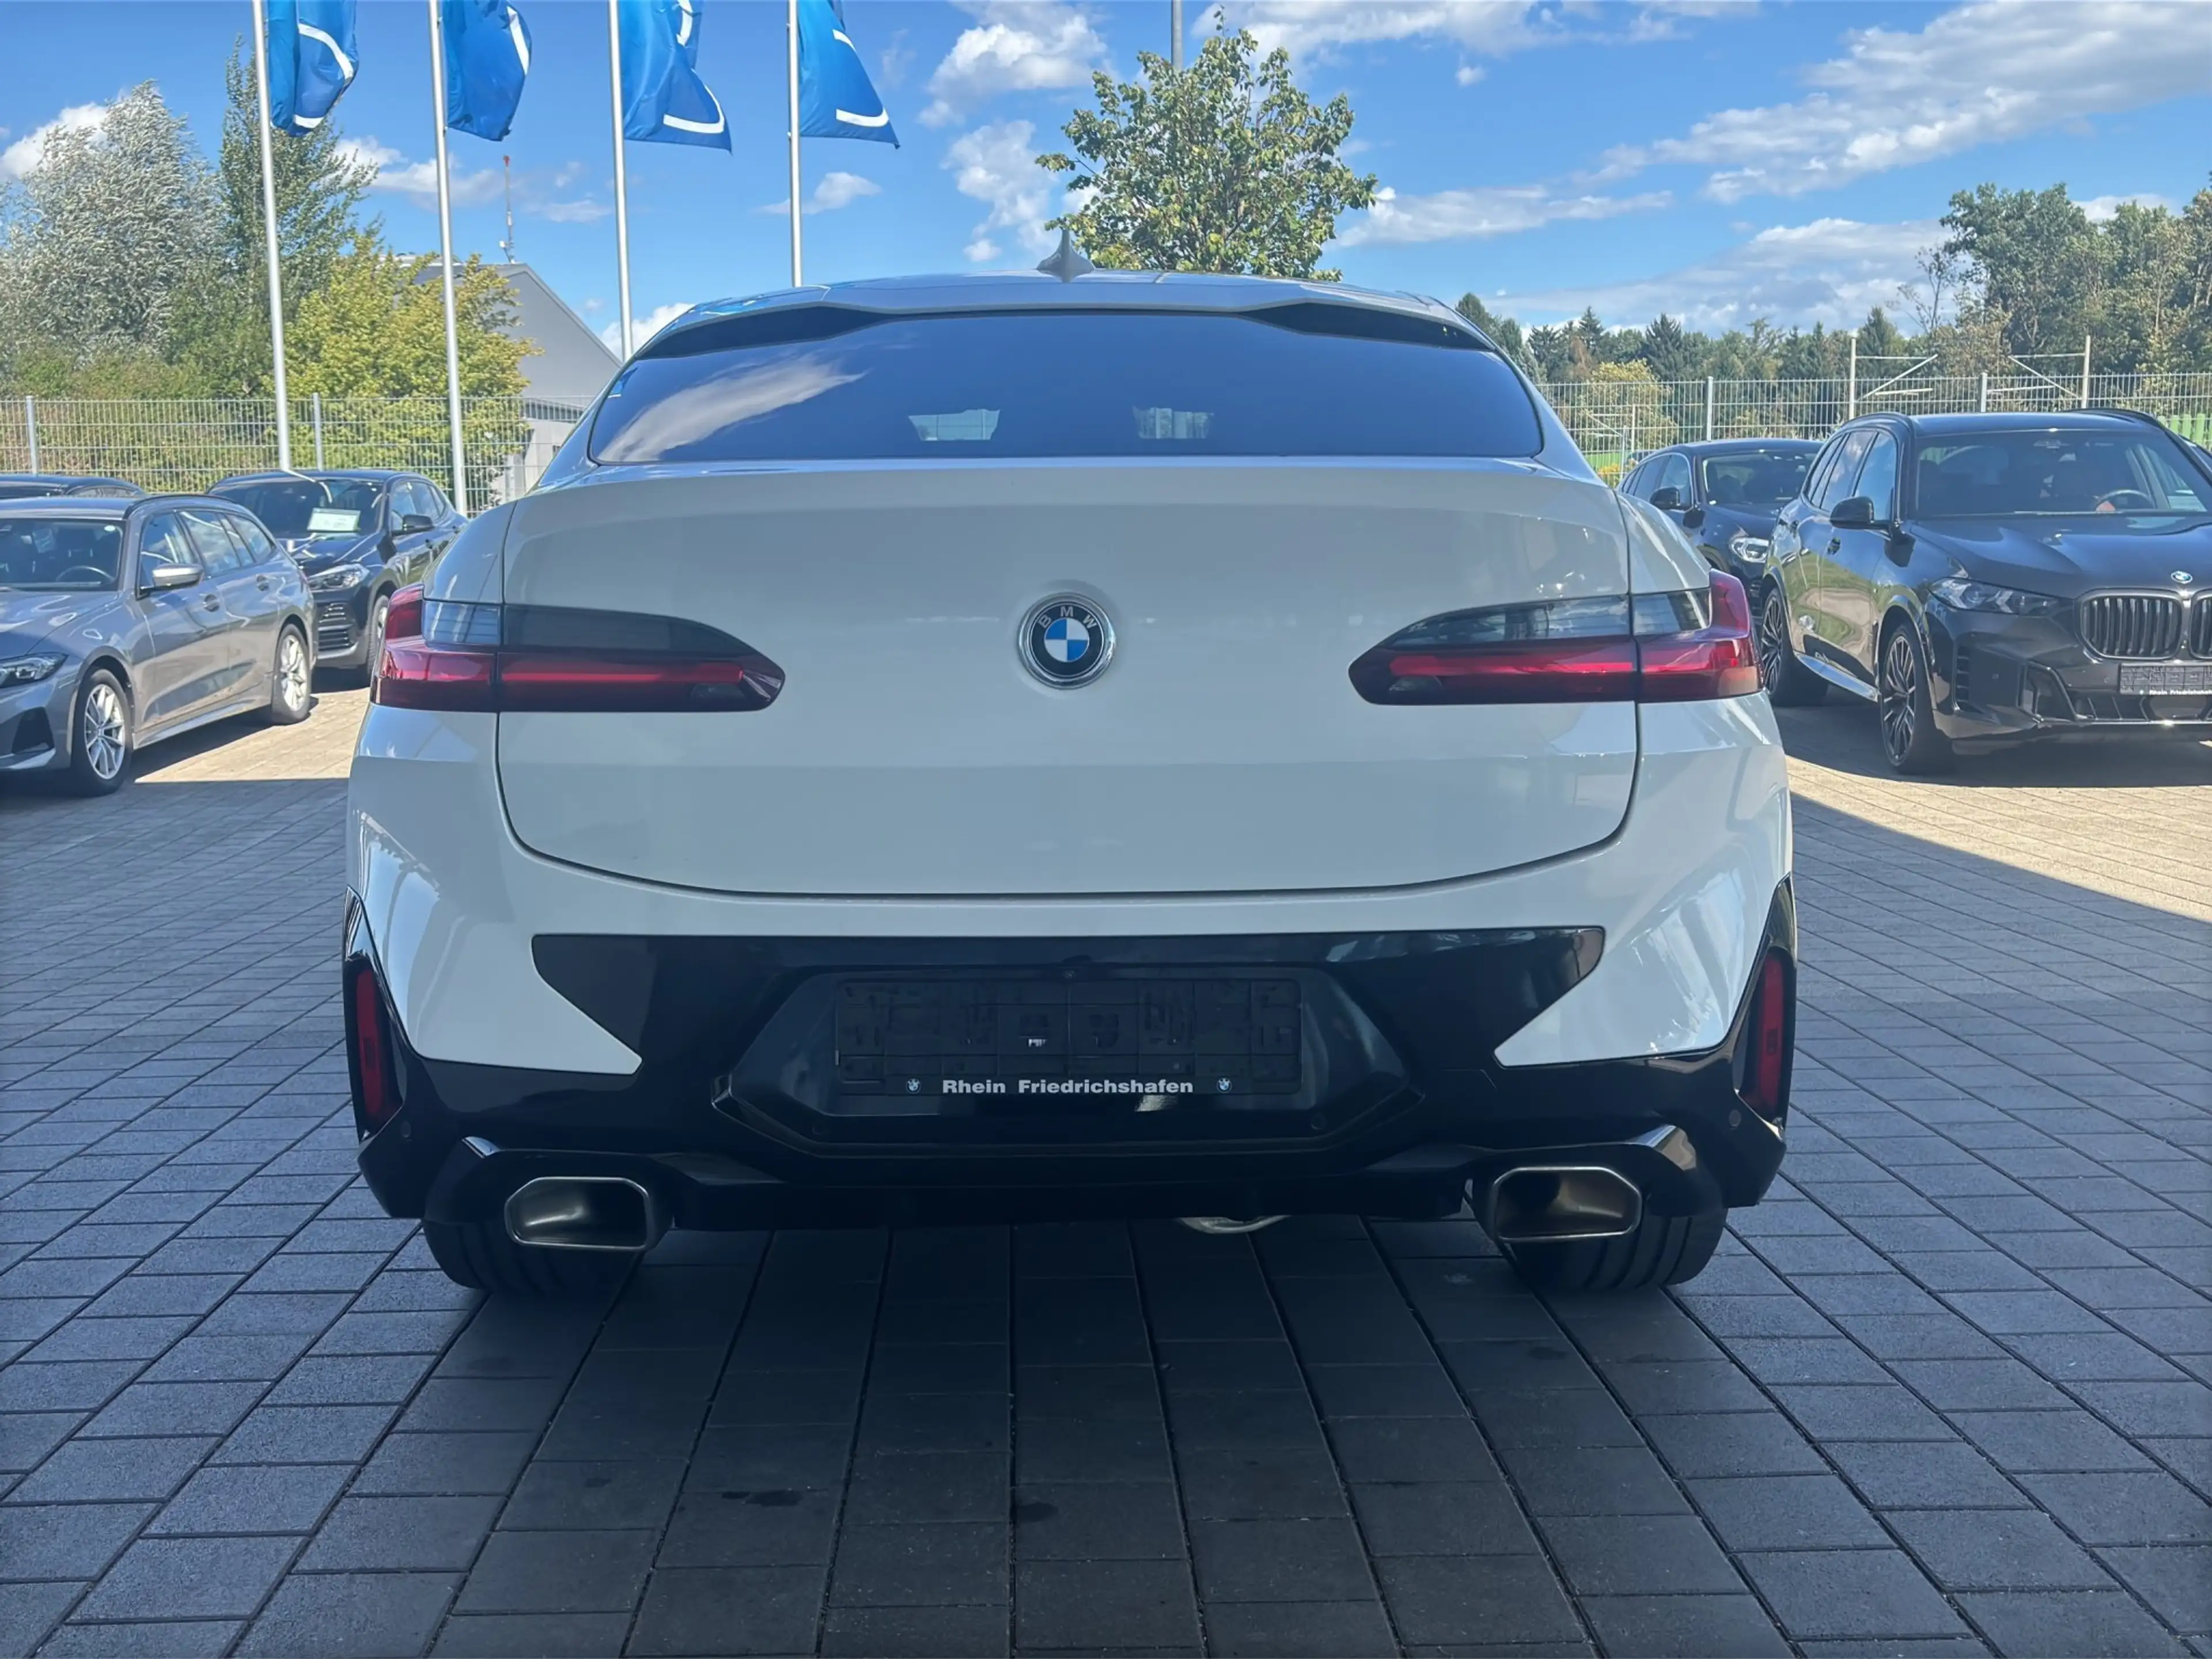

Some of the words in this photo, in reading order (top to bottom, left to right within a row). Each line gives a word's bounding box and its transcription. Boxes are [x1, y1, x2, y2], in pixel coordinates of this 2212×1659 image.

[1037, 605, 1097, 629] BMW
[942, 1079, 1006, 1093] Rhein
[1018, 1079, 1193, 1093] Friedrichshafen
